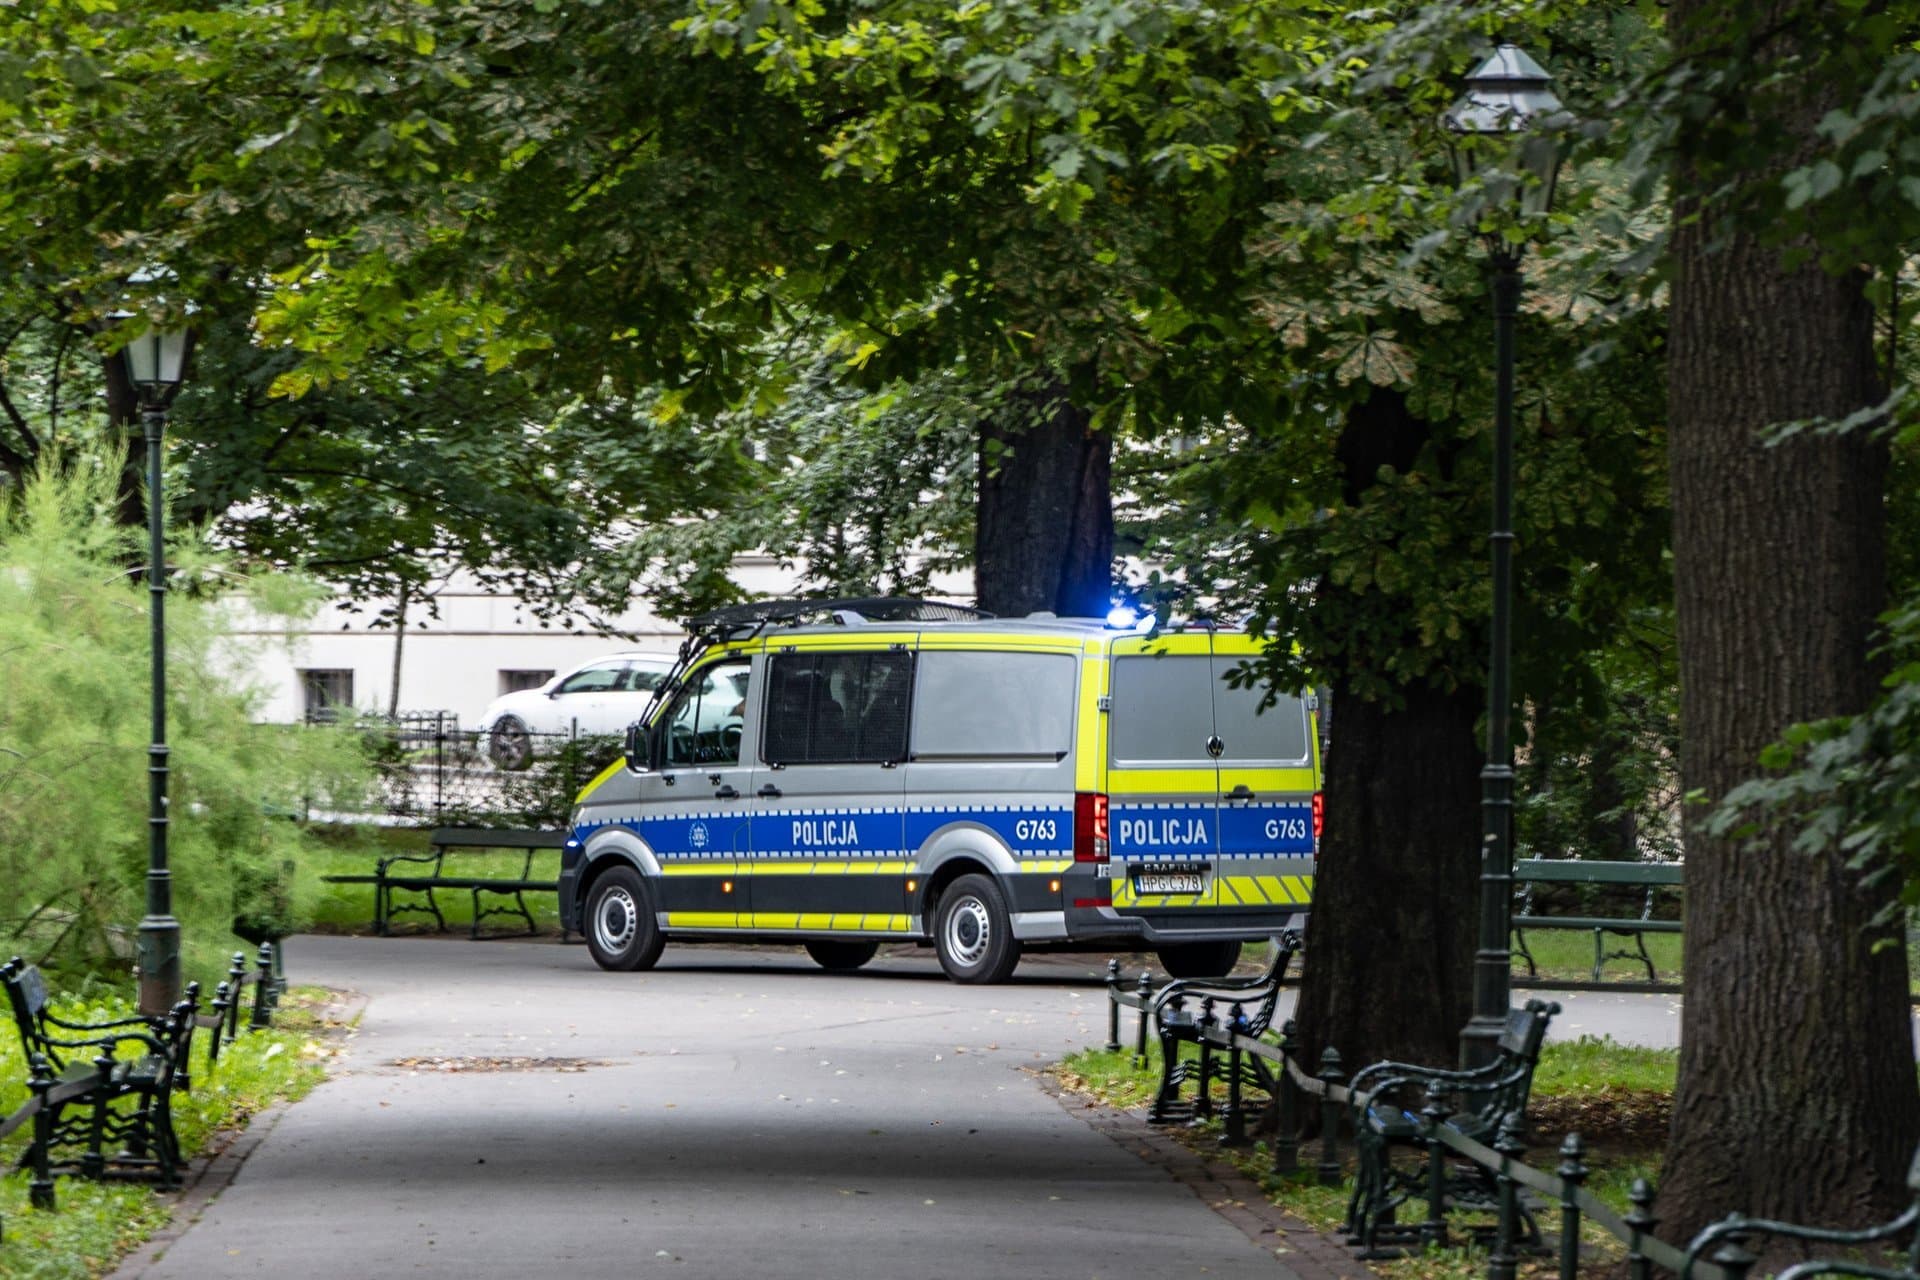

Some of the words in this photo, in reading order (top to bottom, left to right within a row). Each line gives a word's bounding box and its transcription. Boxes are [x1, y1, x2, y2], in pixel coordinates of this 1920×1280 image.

[792, 820, 858, 846] POLICJA
[1016, 819, 1057, 841] G763
[1120, 819, 1208, 845] POLICJA
[1265, 819, 1306, 840] G763
